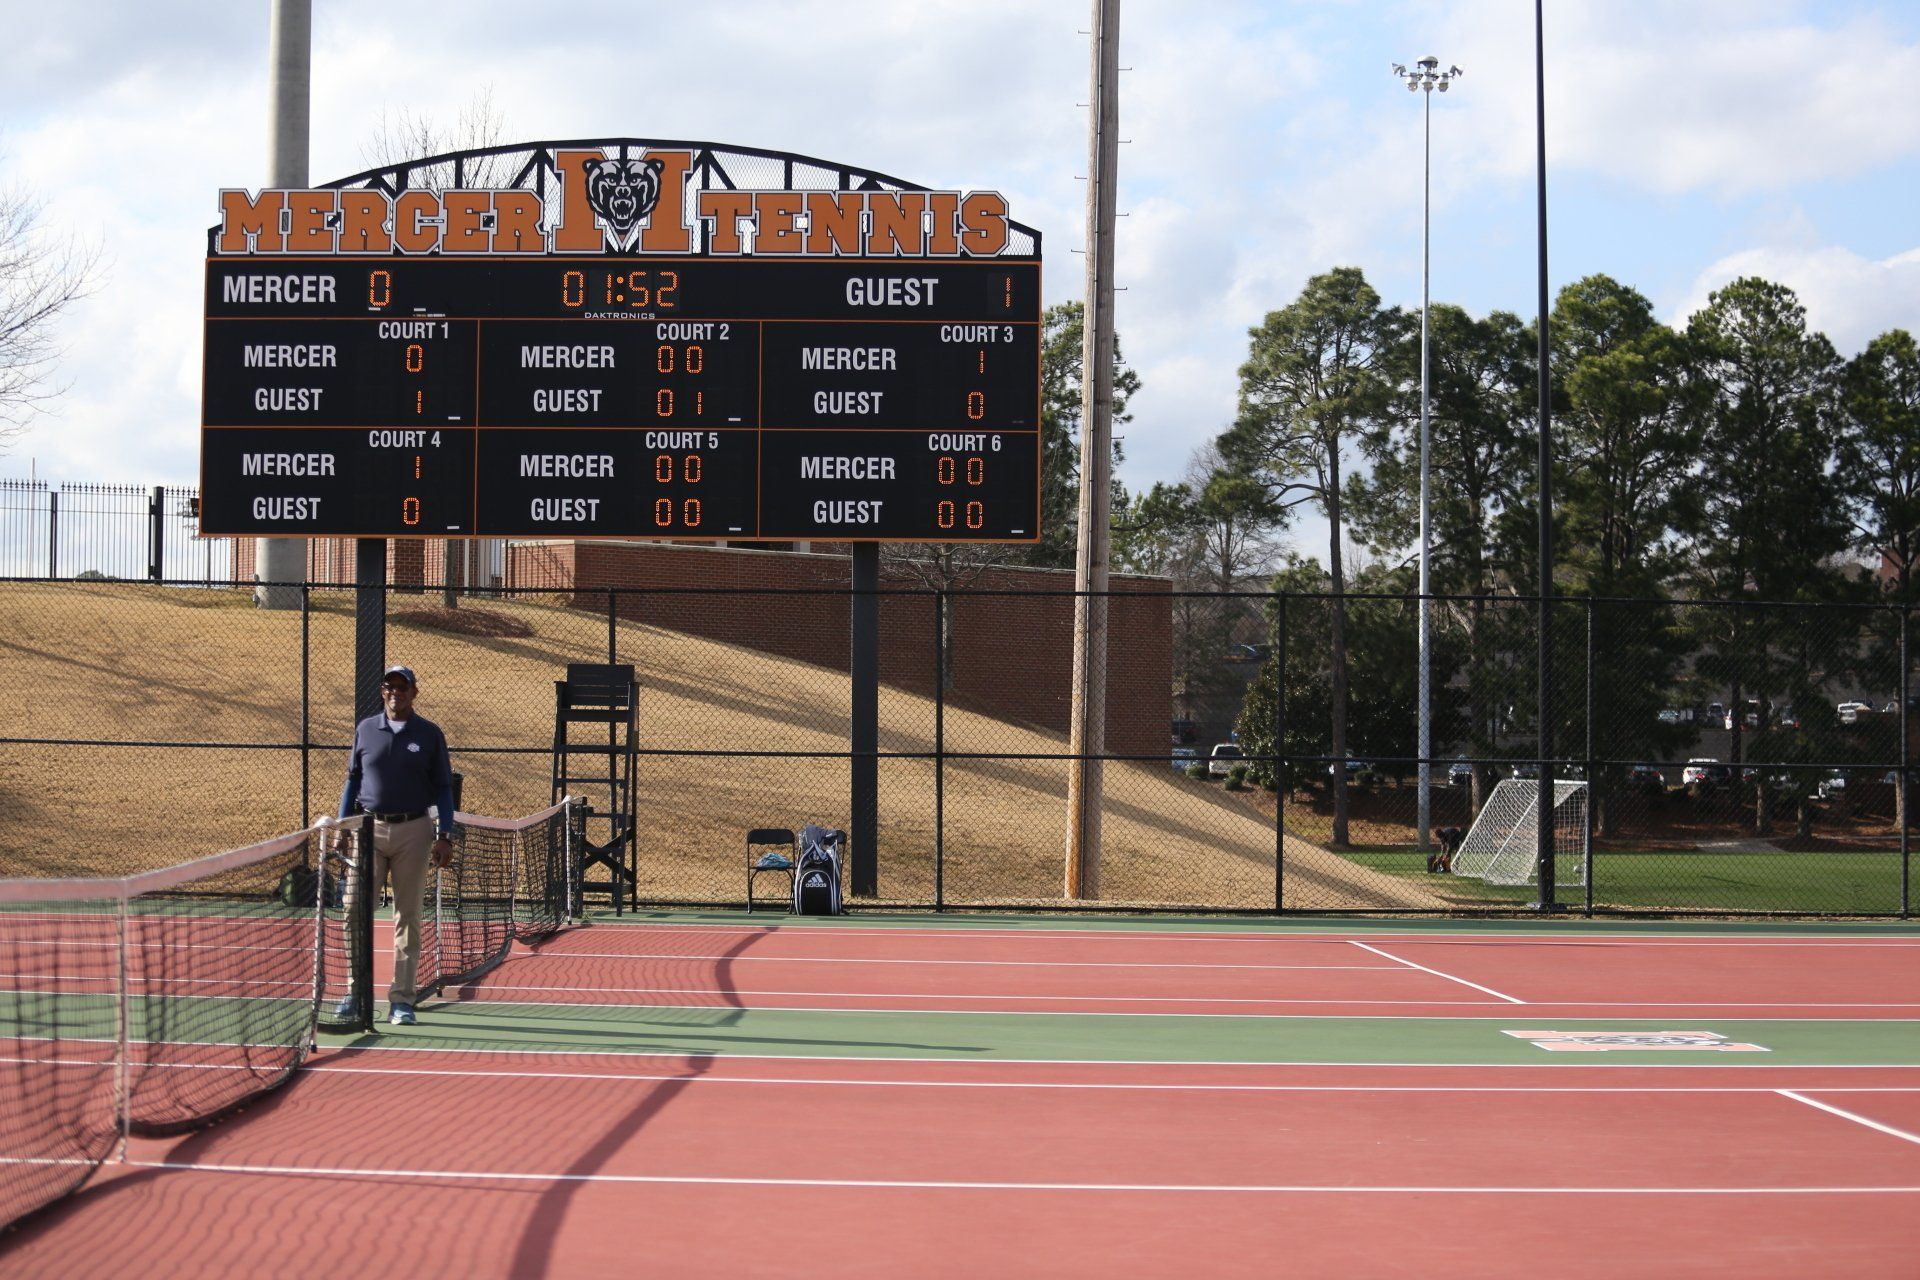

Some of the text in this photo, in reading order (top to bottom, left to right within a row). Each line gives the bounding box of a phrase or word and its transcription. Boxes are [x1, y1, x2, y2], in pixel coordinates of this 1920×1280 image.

[218, 188, 548, 255] MERCER
[696, 189, 1010, 257] TENNIS
[223, 274, 337, 304] MERCER
[369, 270, 391, 307] 0
[845, 277, 939, 307] GUEST
[378, 321, 449, 340] COURT 1
[656, 322, 730, 341] COURT 2
[940, 324, 1014, 343] COURT 3
[244, 344, 337, 368] MERCER
[406, 344, 423, 373] 0
[521, 345, 615, 369] MERCER
[802, 347, 897, 371] MERCER
[254, 387, 323, 411] GUEST
[533, 388, 603, 413] GUEST
[813, 390, 884, 415] GUEST
[967, 391, 984, 420] 0
[368, 430, 441, 448] COURT 4
[645, 431, 719, 450] COURT 5
[928, 433, 1002, 452] COURT 6
[242, 453, 336, 477] MERCER
[520, 454, 615, 478] MERCER
[801, 456, 896, 480] MERCER
[252, 496, 322, 520] GUEST
[403, 497, 420, 525] 0
[530, 497, 600, 522] GUEST
[813, 500, 883, 524] GUEST
